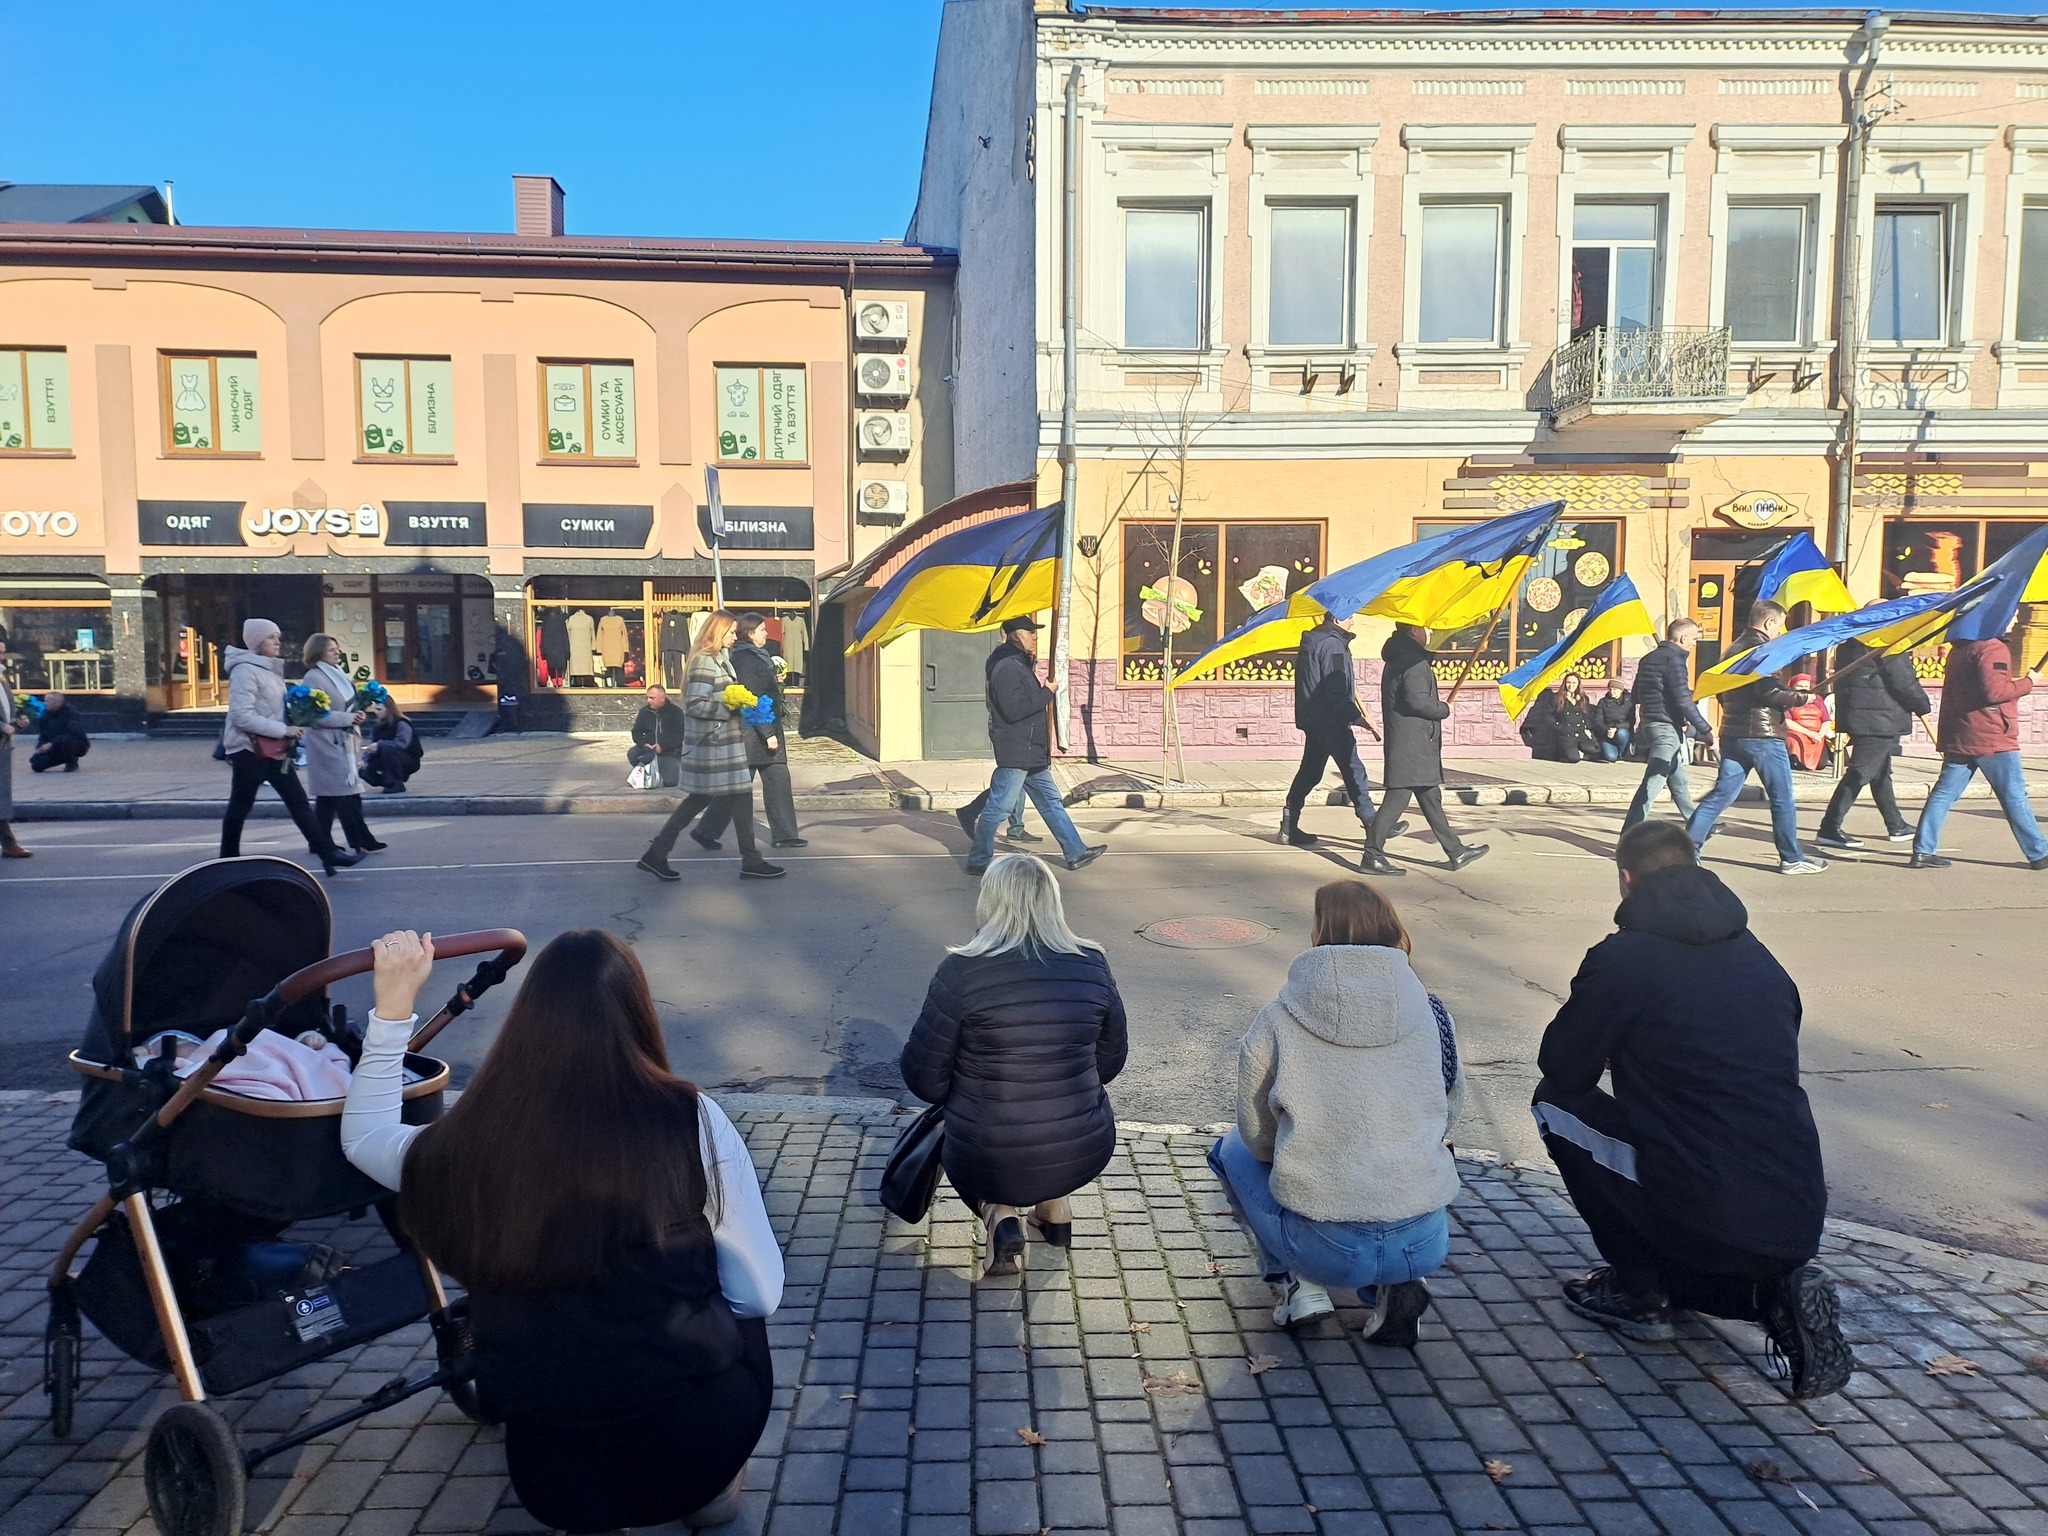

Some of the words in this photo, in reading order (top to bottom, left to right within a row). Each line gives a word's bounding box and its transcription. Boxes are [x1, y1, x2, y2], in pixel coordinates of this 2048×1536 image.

[45, 378, 56, 423] ВЗУТТЯ
[600, 381, 609, 396] ТА
[773, 370, 783, 401] ОДЯГ
[227, 375, 240, 433] ЖІНОЧИЙ
[243, 388, 253, 420] ОДЯГ
[426, 382, 436, 434] БІЛИЗНА
[614, 377, 625, 445] АКСЕСУАРИ
[787, 385, 796, 428] ВЗУТТЯ
[601, 399, 611, 441] СУМКИ
[772, 404, 784, 460] ДИТЯЧИЙ
[788, 431, 796, 446] ТА
[0, 509, 78, 537] OYO
[166, 515, 212, 530] ОДЯГ
[247, 507, 351, 536] JOYS
[408, 516, 470, 529] ВЗУТТЯ
[561, 518, 615, 532] СУМКИ
[724, 520, 788, 533] БІЛИЗНА
